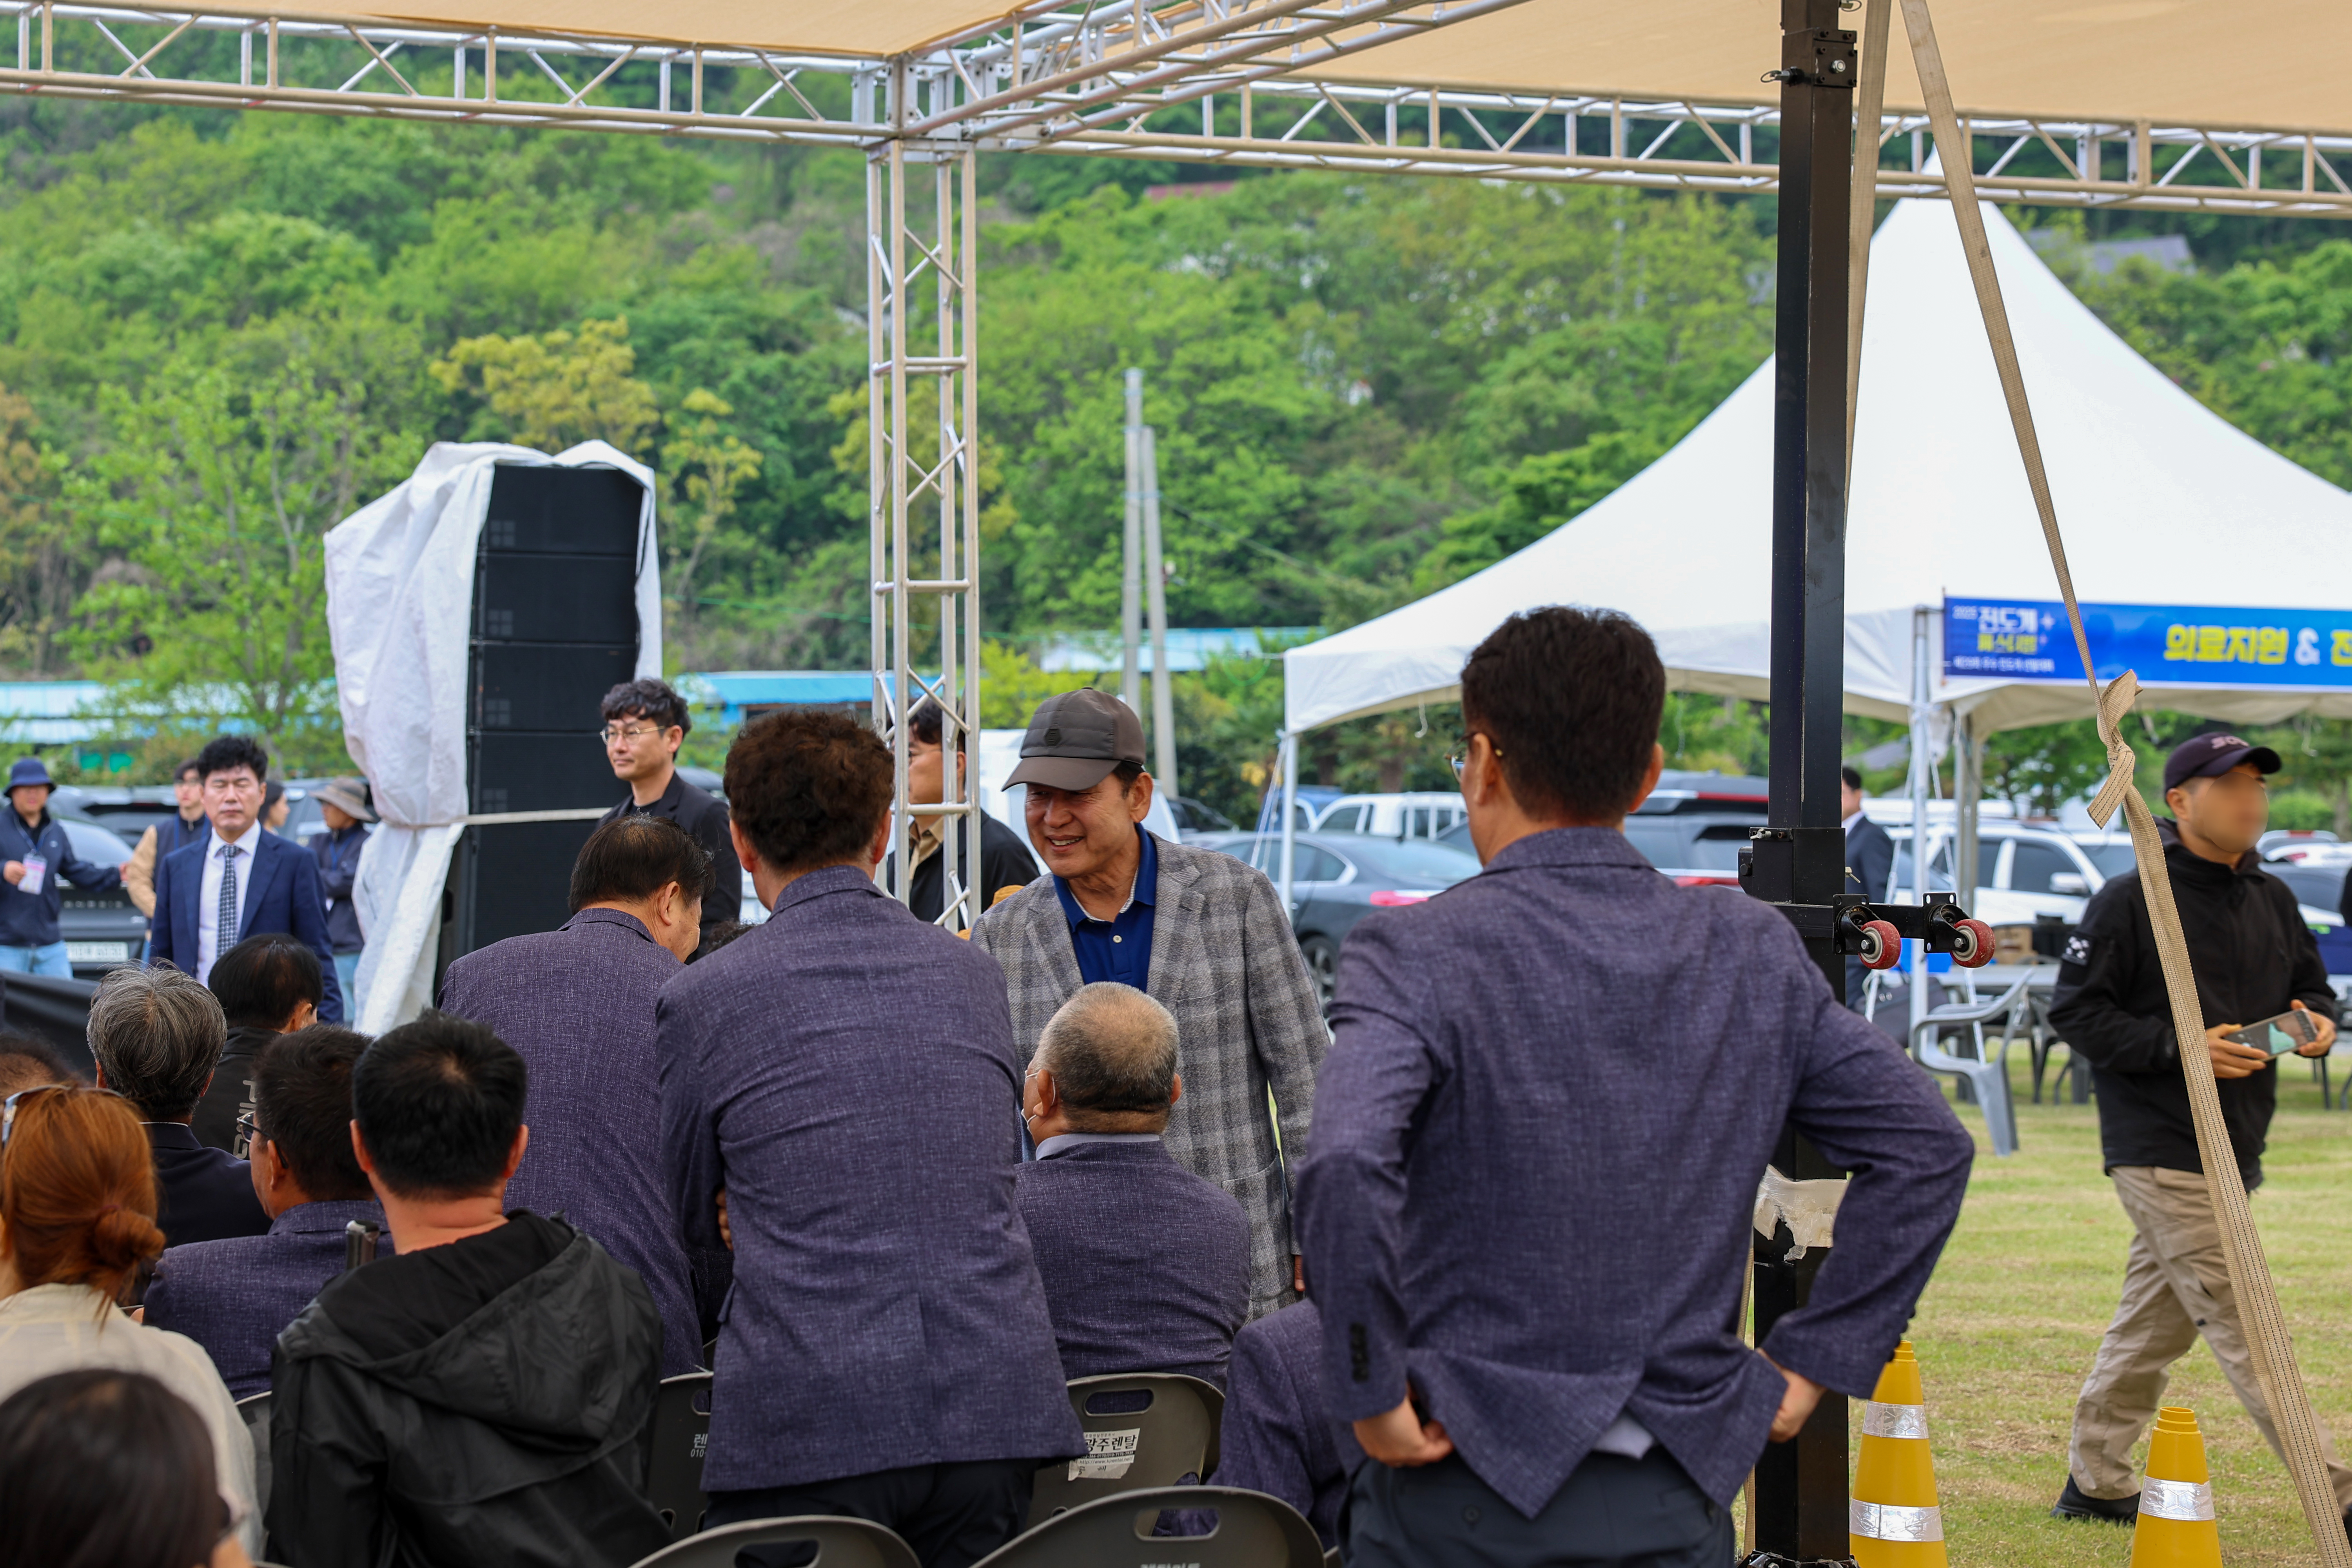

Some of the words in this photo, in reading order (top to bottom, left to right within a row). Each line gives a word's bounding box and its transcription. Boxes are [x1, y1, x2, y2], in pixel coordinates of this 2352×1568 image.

[2163, 624, 2289, 665] 의료지원
[2295, 628, 2320, 666] &
[233, 1080, 257, 1159] PIG
[1086, 1435, 1136, 1452] 광주렌탈
